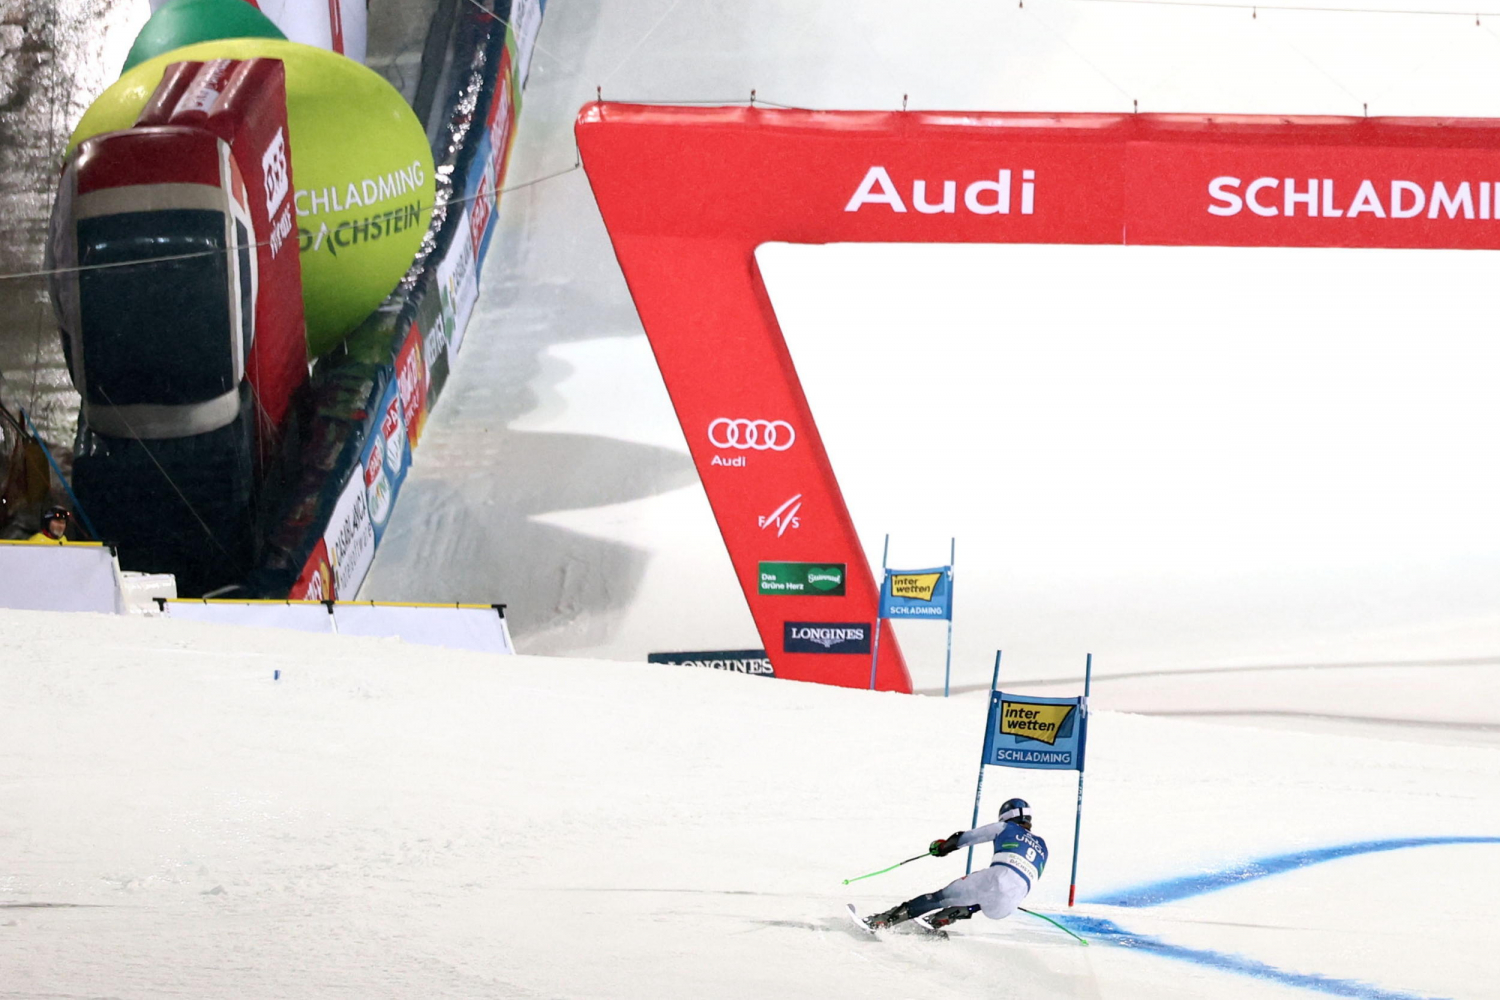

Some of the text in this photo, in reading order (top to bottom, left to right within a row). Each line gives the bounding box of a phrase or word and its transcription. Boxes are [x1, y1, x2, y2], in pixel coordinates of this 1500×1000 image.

[294, 160, 425, 218] CHLADMING
[844, 166, 1036, 215] Audi
[711, 455, 747, 468] Audi
[761, 573, 777, 581] Das
[893, 574, 918, 586] inter
[761, 582, 805, 590] Grüne Herz
[895, 584, 931, 594] wetten
[890, 606, 943, 615] SCHLADMING
[791, 627, 864, 640] LONGINES
[667, 658, 774, 674] GINES
[1004, 703, 1041, 720] inter
[1006, 719, 1056, 733] wetten
[997, 749, 1071, 764] SCHLADMING
[1025, 847, 1037, 863] 9
